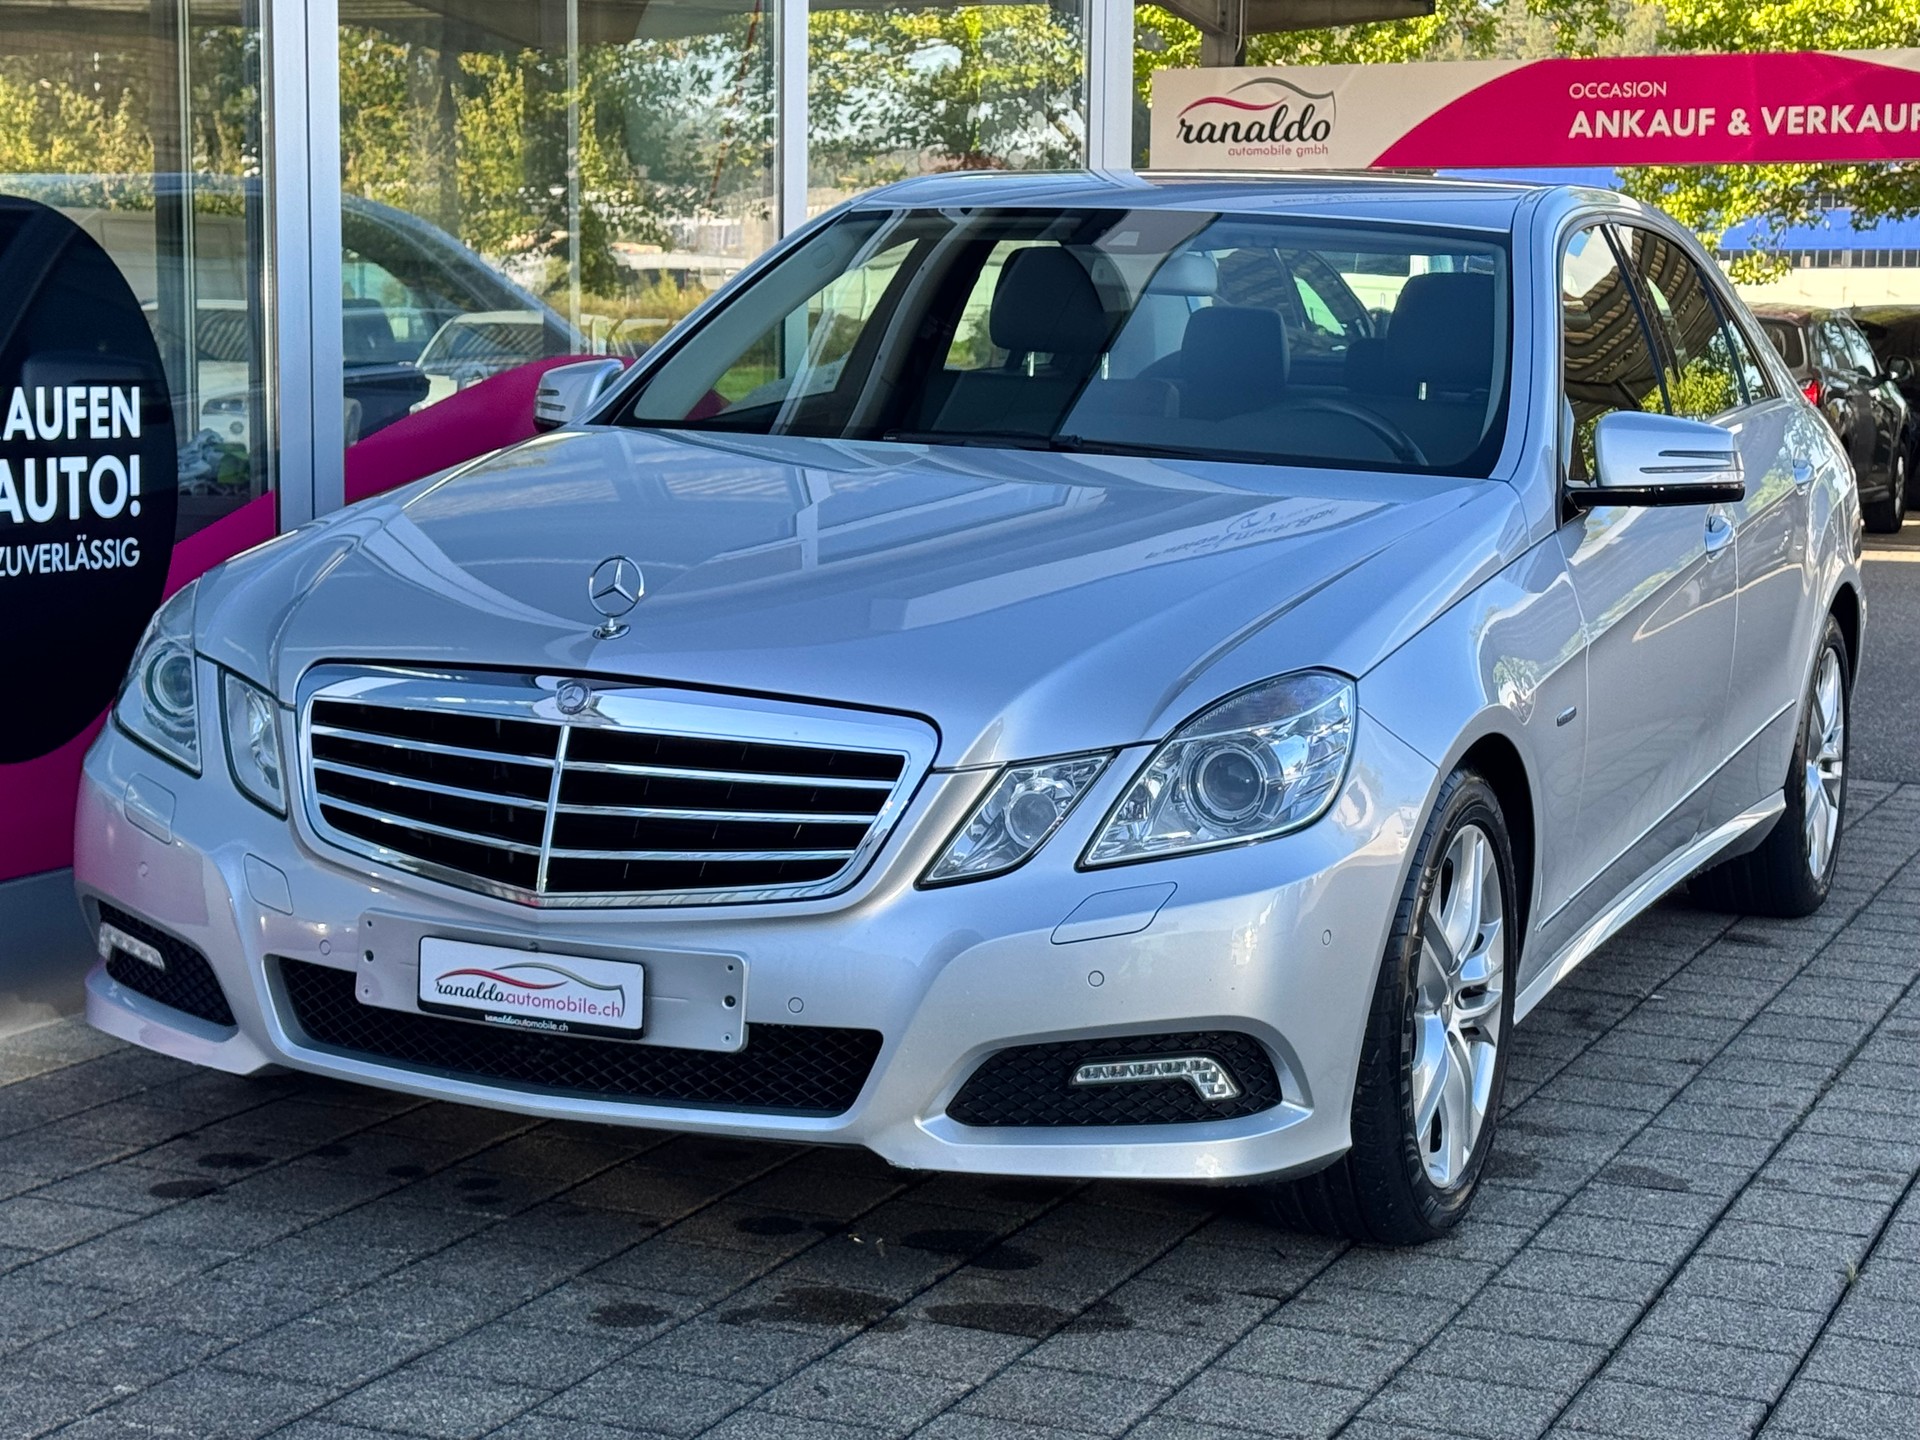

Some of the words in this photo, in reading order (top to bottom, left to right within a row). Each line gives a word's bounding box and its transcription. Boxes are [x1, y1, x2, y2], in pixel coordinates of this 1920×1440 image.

[1568, 81, 1667, 99] OCCASION
[1176, 103, 1331, 144] ranaldo
[1568, 108, 1716, 139] ANKAUF
[1727, 108, 1752, 136] &
[1227, 144, 1292, 156] automobile
[1296, 144, 1329, 158] gmbh
[0, 386, 141, 441] AUFEN
[0, 454, 141, 523] AUTO!
[434, 979, 622, 1018] ranaldoautomobile.ch
[484, 1013, 569, 1032] ranaldoautomobile.ch
